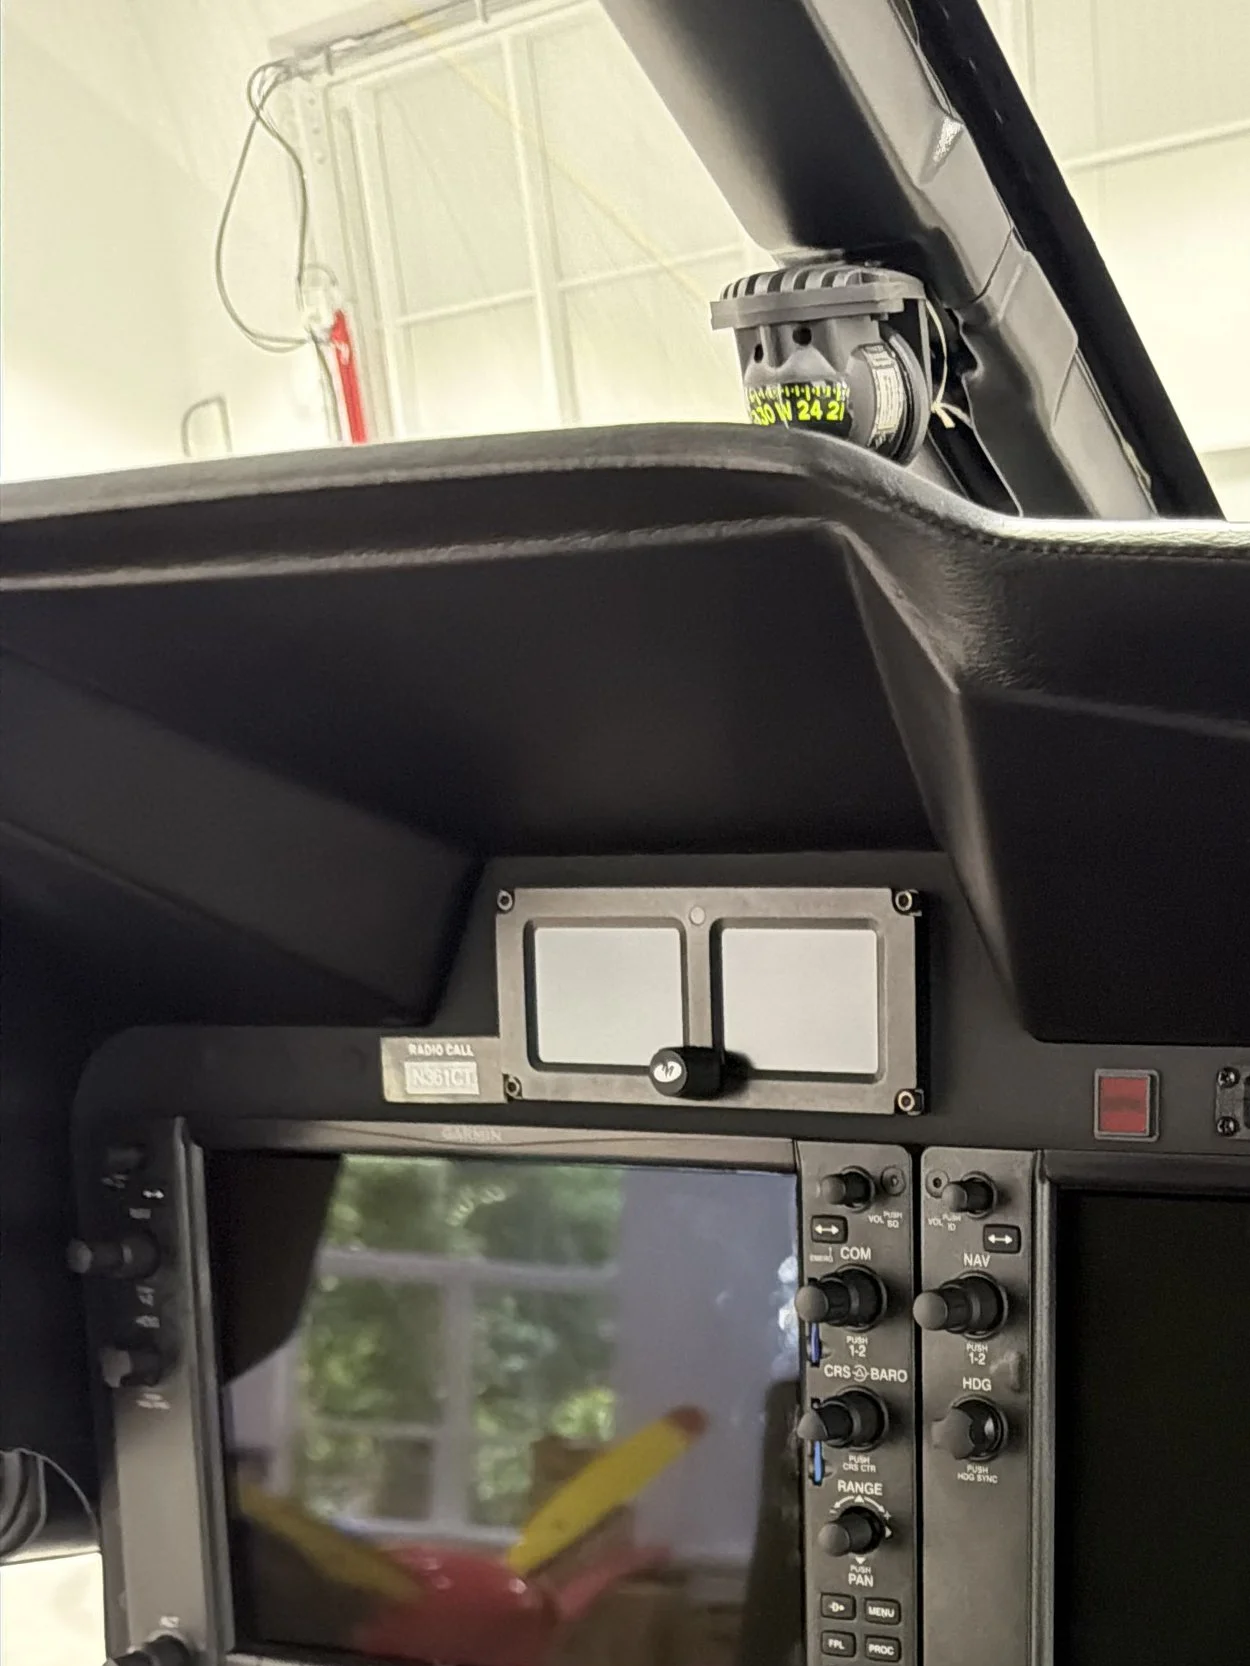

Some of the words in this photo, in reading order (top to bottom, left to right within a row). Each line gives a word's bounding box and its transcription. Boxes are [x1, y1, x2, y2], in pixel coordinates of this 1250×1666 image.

[797, 400, 822, 420] 24
[408, 1044, 443, 1055] RADIO
[446, 1044, 474, 1056] CALL
[868, 1214, 884, 1224] VOL
[884, 1211, 902, 1219] PUSH
[928, 1218, 943, 1227] VOL
[840, 1247, 871, 1260] COM
[964, 1253, 990, 1268] NAV
[847, 1336, 868, 1345] PUSH
[849, 1346, 866, 1357] 1-2
[966, 1344, 988, 1353] PUSH
[969, 1354, 986, 1366] 1-2
[824, 1364, 850, 1377] CRS
[871, 1369, 907, 1383] BARO
[963, 1377, 991, 1391] HDG
[849, 1455, 869, 1464] PUSH
[967, 1465, 988, 1474] PUSH
[977, 1474, 998, 1483] SYNC
[838, 1480, 882, 1495] RANGE
[850, 1565, 871, 1574] PUSH
[848, 1573, 873, 1587] PAN
[868, 1607, 894, 1617] MENU
[828, 1639, 844, 1649] FPL
[869, 1645, 894, 1655] PROC
